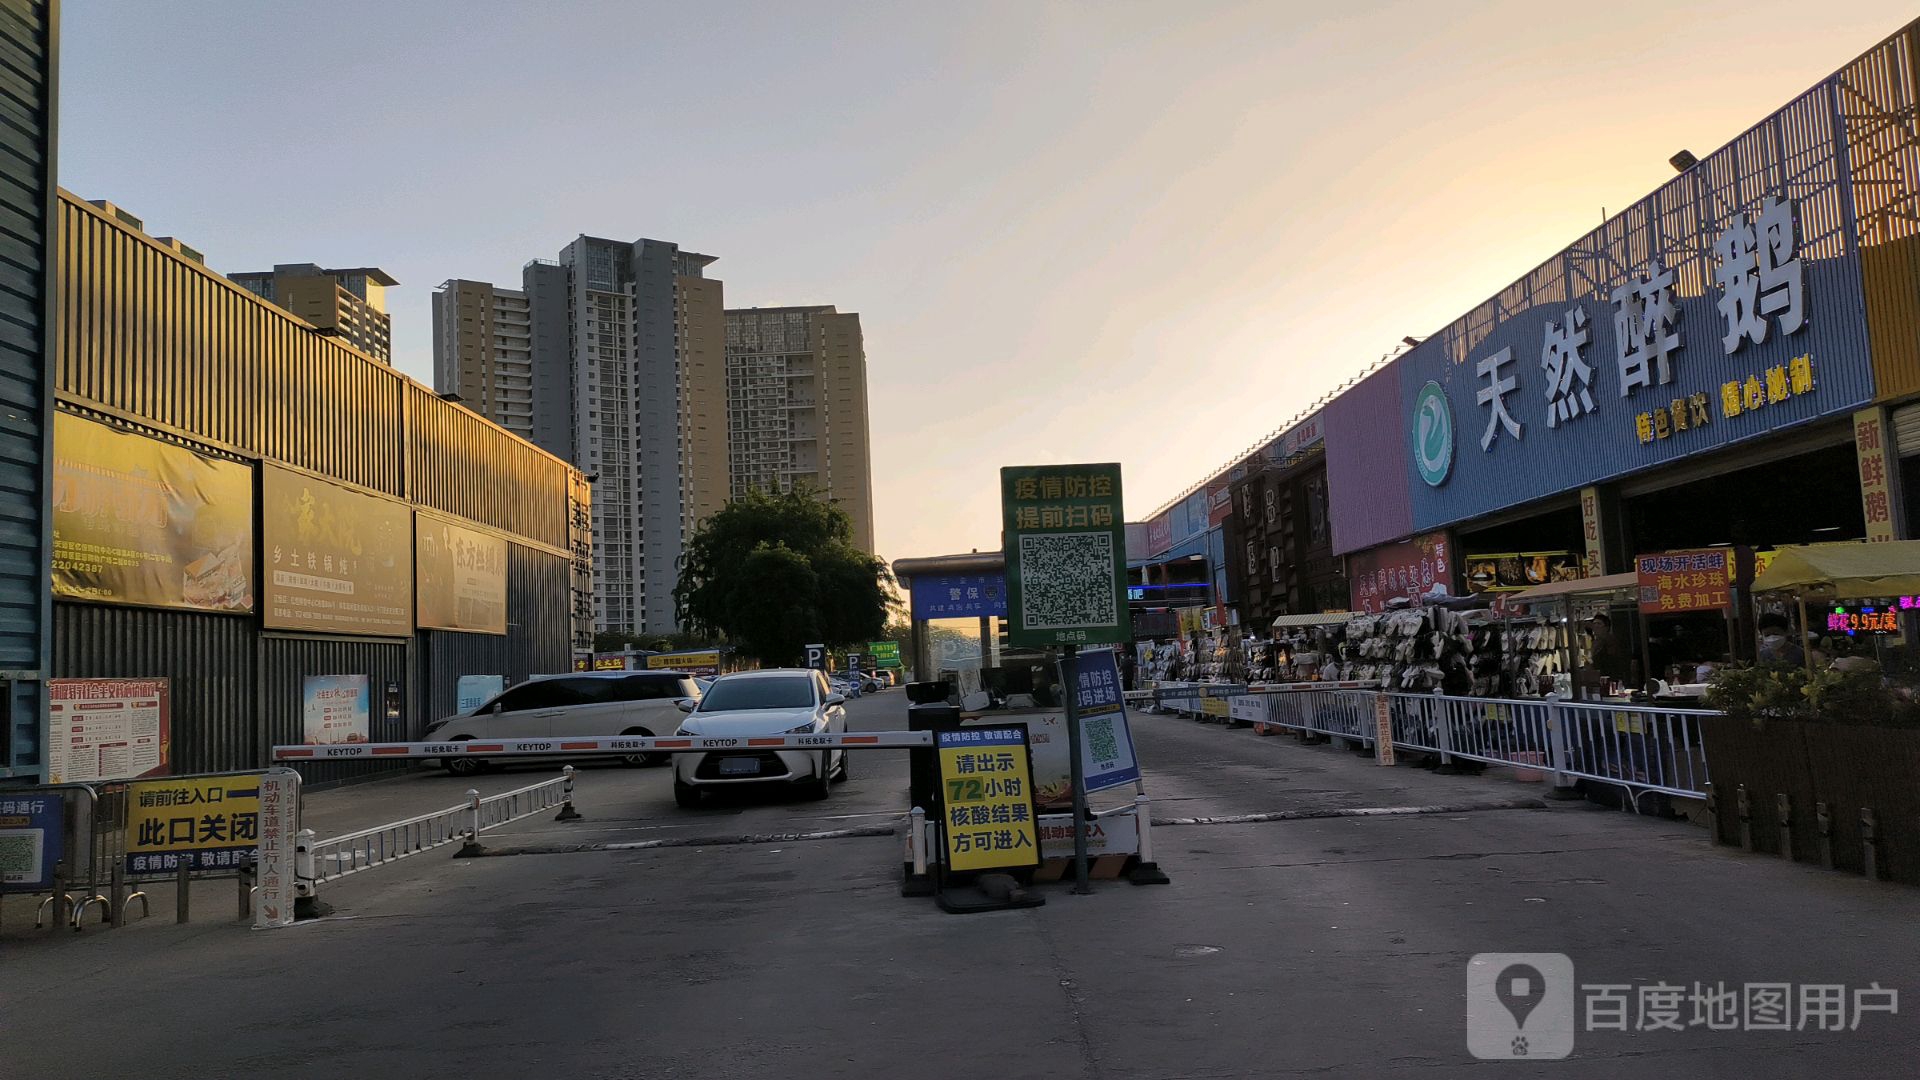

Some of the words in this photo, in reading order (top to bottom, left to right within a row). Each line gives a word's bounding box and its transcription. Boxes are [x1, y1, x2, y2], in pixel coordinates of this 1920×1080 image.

[1476, 196, 1807, 453] 天然醉鹅
[1636, 392, 1709, 444] 特色餐饮
[1721, 353, 1813, 418] 精心秘制
[1015, 474, 1112, 499] 疫情防控
[1857, 419, 1890, 542] 新鲜鹅
[1016, 504, 1112, 529] 提前扫码
[1583, 496, 1600, 577] 好吃实
[1641, 552, 1724, 574] 现场开活蚌
[1657, 571, 1725, 590] 海水珍珠
[1660, 591, 1728, 610] 免费加工
[1056, 630, 1087, 642] 地点码
[1077, 669, 1113, 690] 情防控
[516, 742, 552, 751] KEYTOP
[611, 740, 646, 748] 科拓免取卡
[703, 738, 738, 747] KEYTOP
[798, 736, 833, 745] 科拓免取卡
[942, 731, 981, 743] 疫情防控
[984, 730, 1022, 740] 敬请配合
[327, 748, 362, 757] KEYTOP
[956, 753, 1015, 774] 请出示
[139, 787, 223, 808] 请前往入口
[949, 777, 1021, 801] 72小时
[0, 801, 45, 814] 码通行
[951, 803, 1030, 827] 核酸结果
[137, 812, 258, 847] 此口关闭
[263, 780, 281, 900] 机动车道禁止行人通行
[953, 829, 1032, 853] 方可进入
